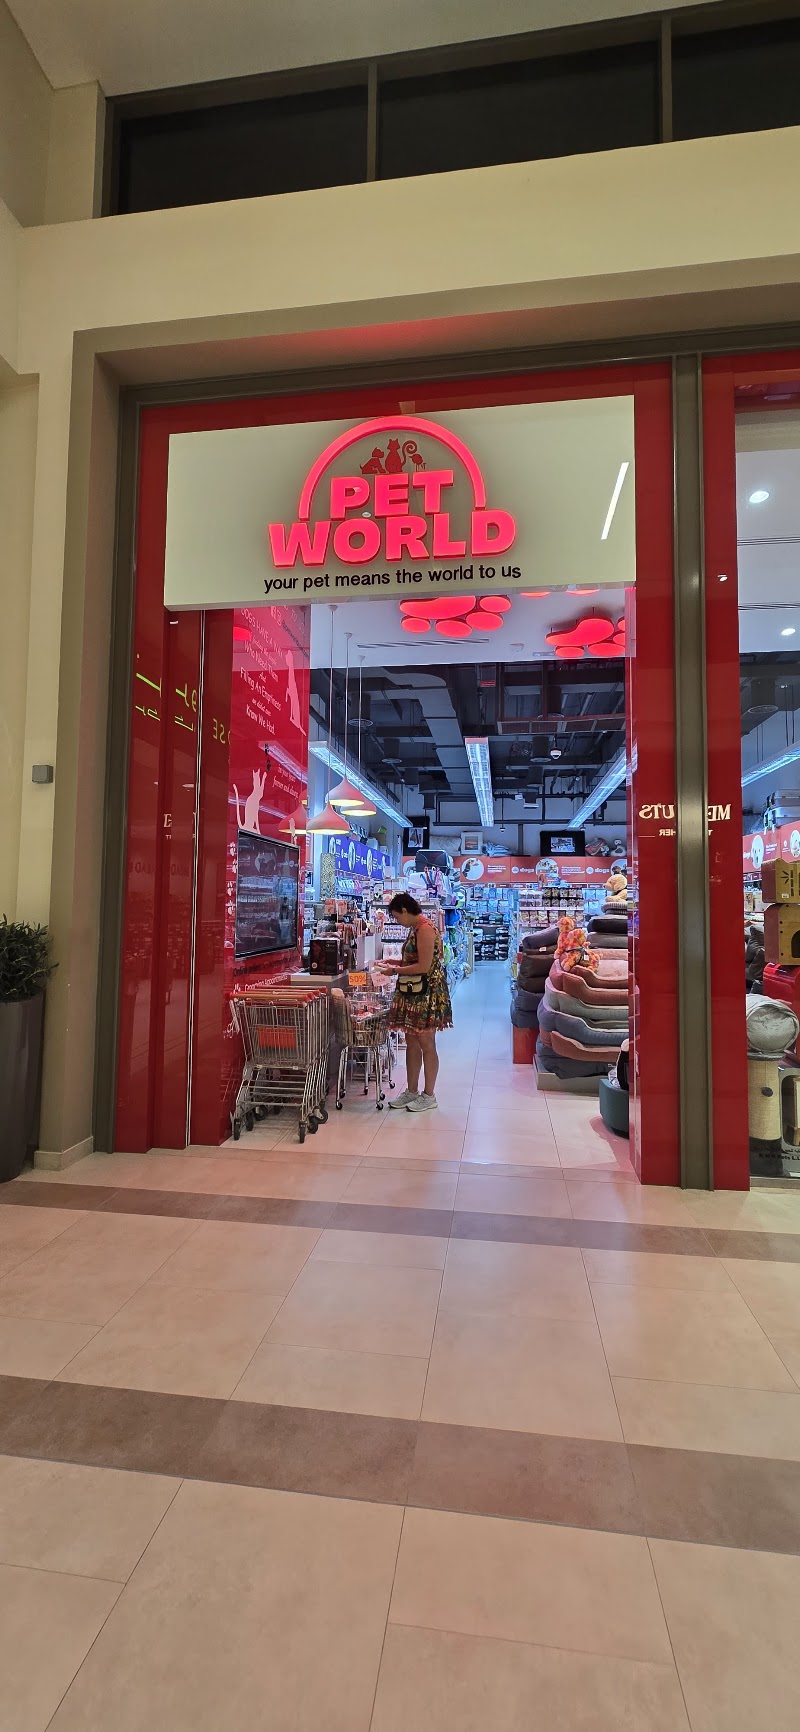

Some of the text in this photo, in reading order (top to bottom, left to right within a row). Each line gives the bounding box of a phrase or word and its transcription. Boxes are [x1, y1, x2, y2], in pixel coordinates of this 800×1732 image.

[330, 469, 454, 521] PET
[268, 509, 516, 569] WORLD
[264, 564, 522, 594] your pet means the world to us
